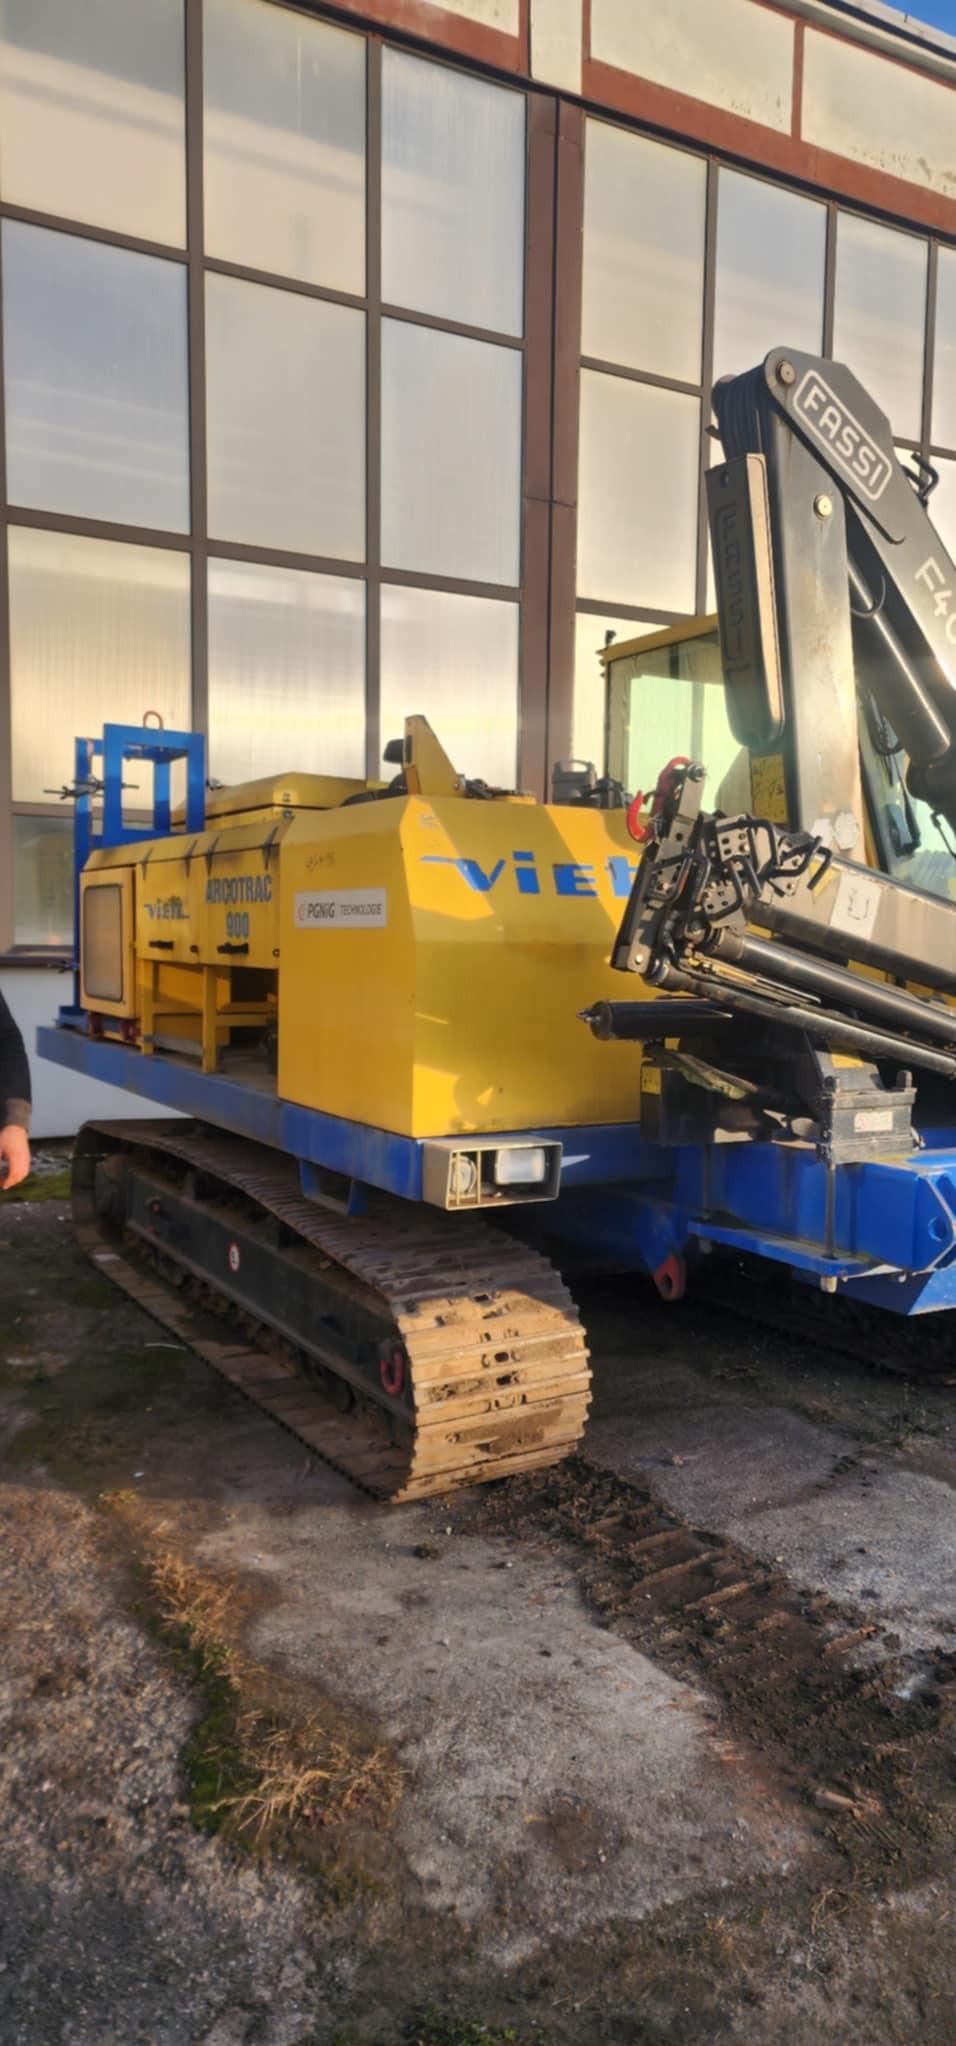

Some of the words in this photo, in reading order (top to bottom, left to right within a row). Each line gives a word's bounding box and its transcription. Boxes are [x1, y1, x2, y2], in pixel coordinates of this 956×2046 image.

[803, 385, 884, 488] FASSI
[722, 509, 745, 654] FASSI
[206, 875, 273, 904] ARCOTRAC
[340, 903, 382, 916] TECHNOLOGIE
[225, 911, 250, 938] 900
